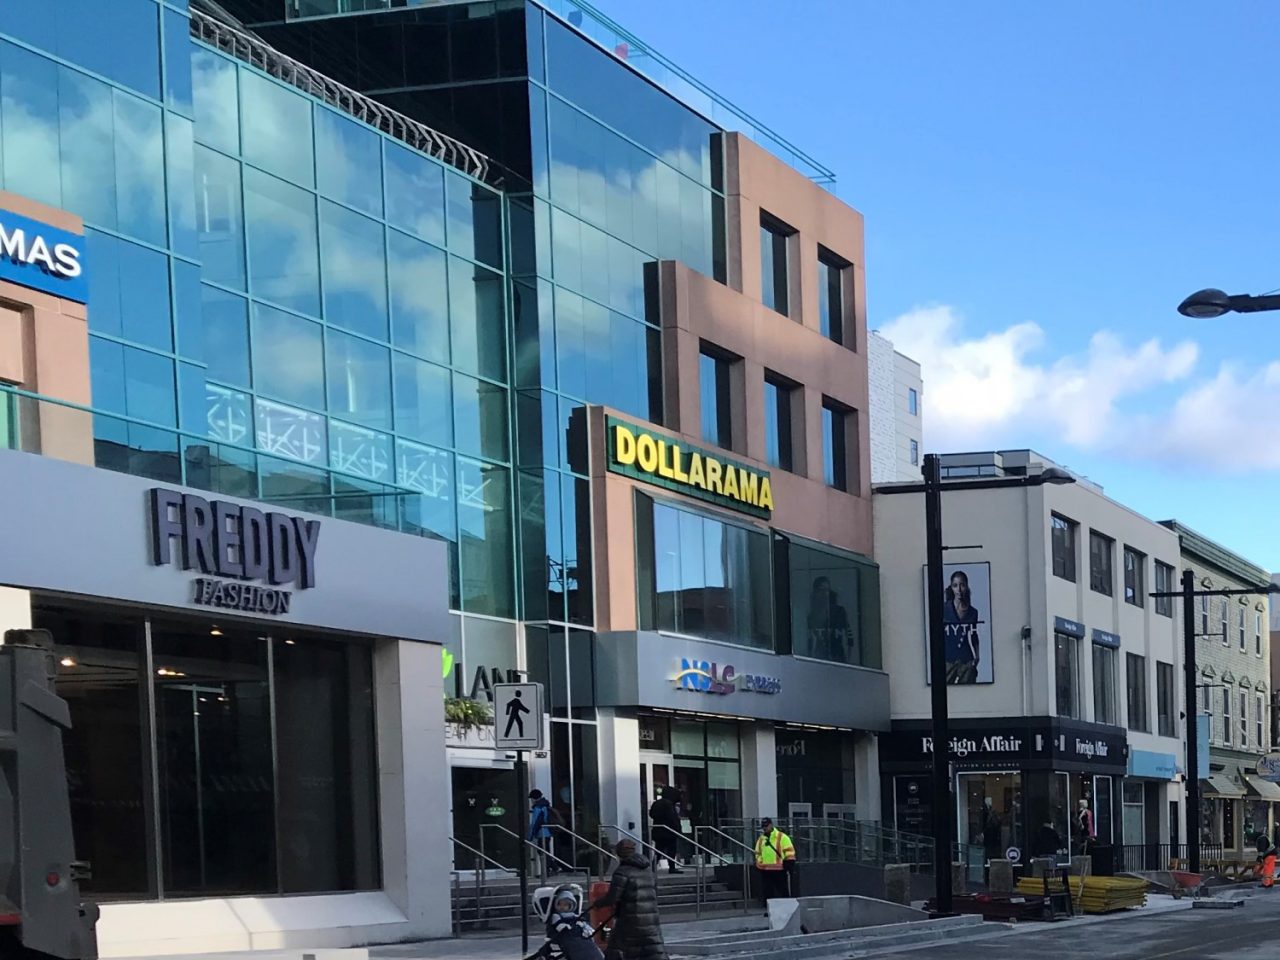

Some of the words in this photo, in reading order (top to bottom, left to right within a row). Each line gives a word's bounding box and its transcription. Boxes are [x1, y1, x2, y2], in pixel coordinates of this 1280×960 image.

[0, 222, 81, 277] MAS
[615, 425, 774, 511] DOLLARAMA
[151, 487, 321, 590] FREDDY
[194, 578, 292, 615] FASHION
[678, 658, 736, 695] NSLC
[980, 736, 1022, 752] Affair
